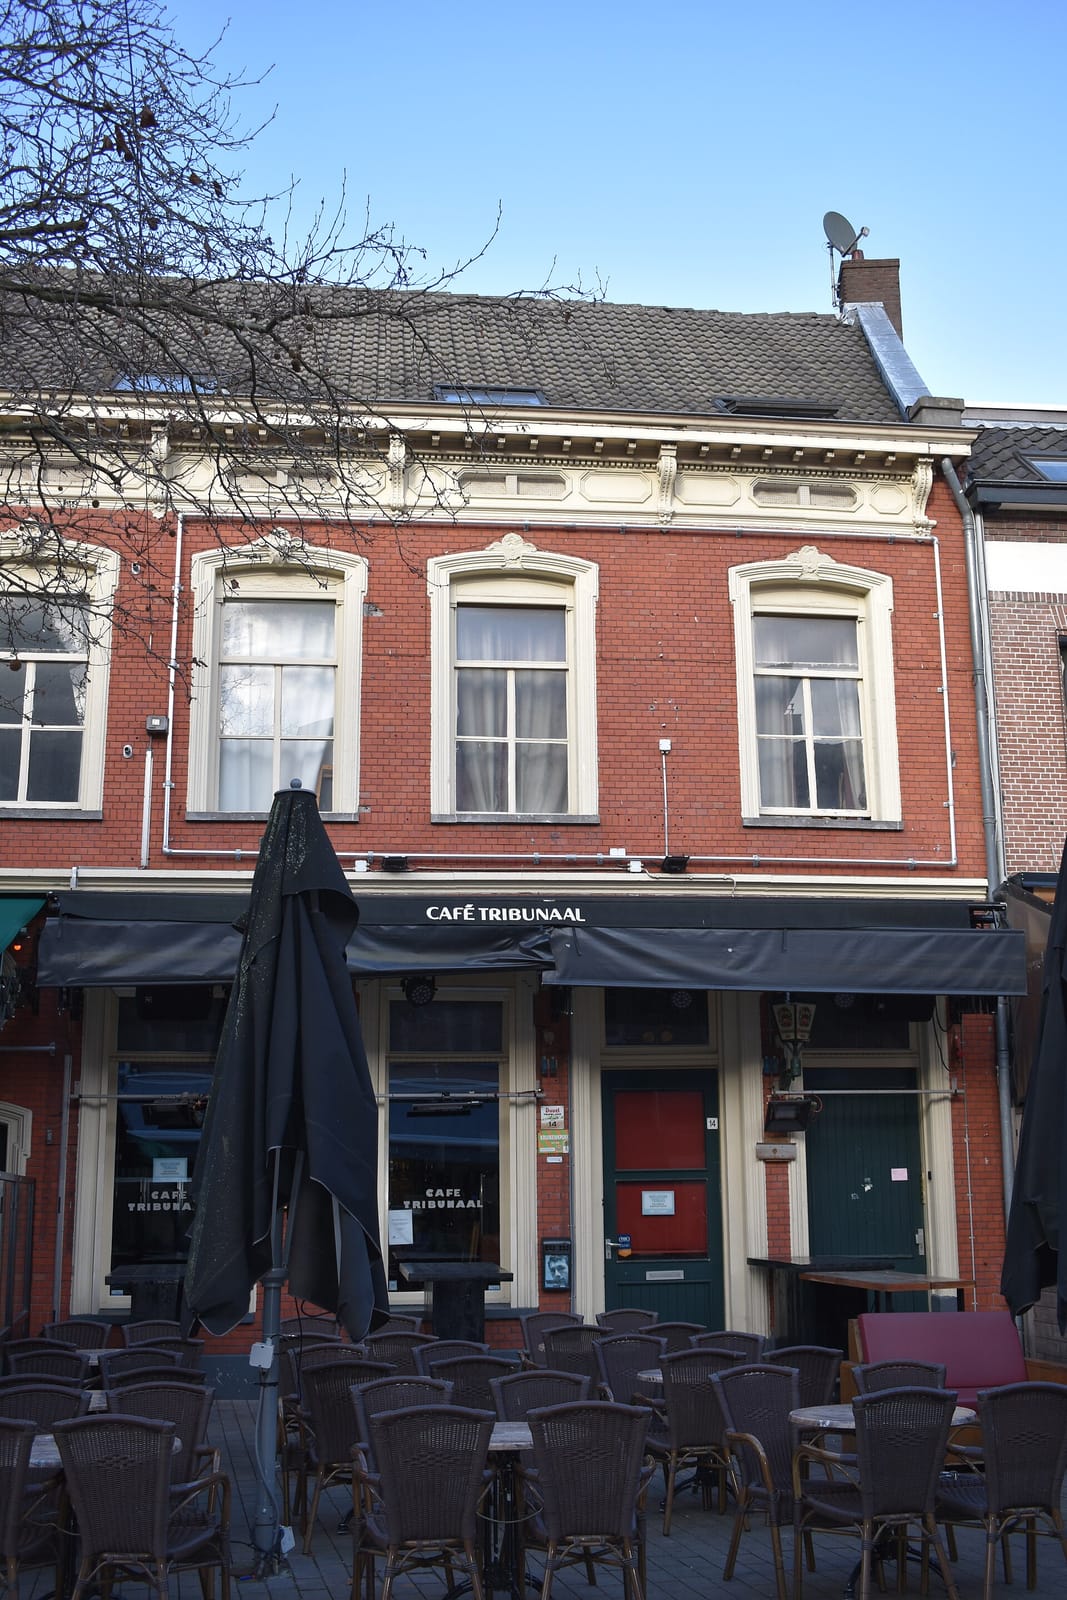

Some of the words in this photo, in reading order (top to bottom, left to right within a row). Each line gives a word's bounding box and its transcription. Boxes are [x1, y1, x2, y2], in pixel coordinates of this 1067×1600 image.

[426, 904, 475, 921] CAFÉ
[477, 907, 586, 922] TRIBUNAAL
[151, 1190, 188, 1200] CAFE
[425, 1188, 461, 1198] CAFE
[127, 1202, 193, 1212] TRIBUNA
[403, 1199, 483, 1209] TRIBUNAAL
